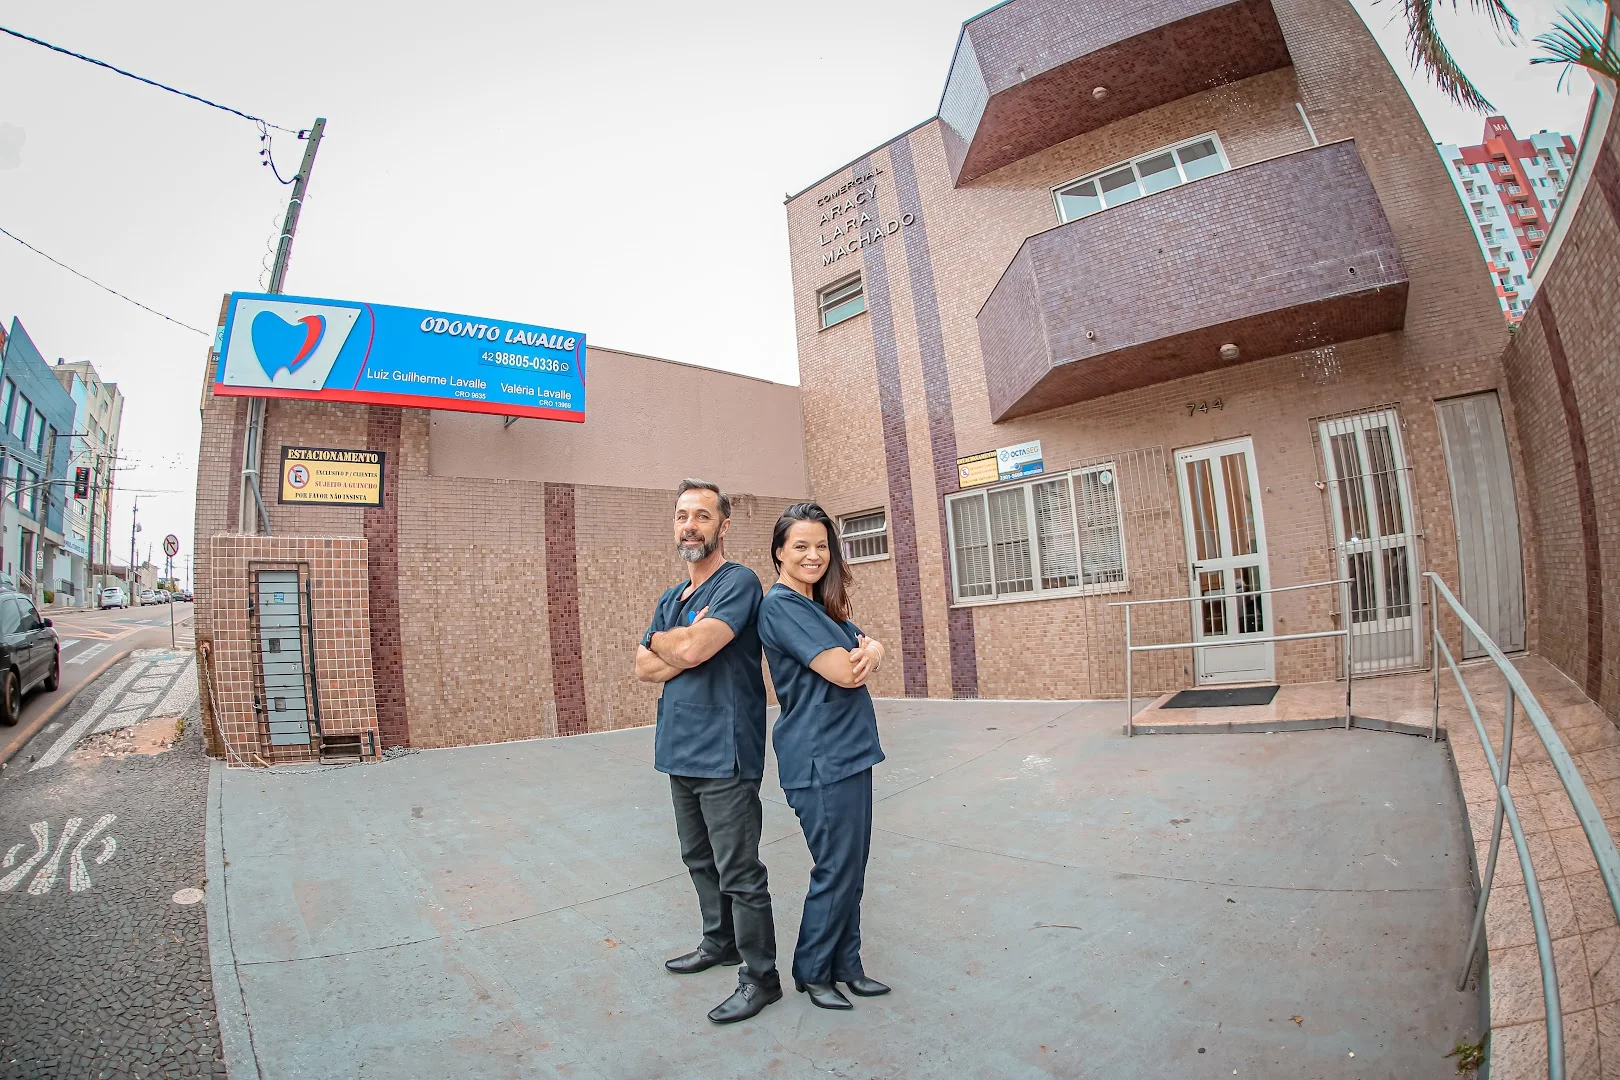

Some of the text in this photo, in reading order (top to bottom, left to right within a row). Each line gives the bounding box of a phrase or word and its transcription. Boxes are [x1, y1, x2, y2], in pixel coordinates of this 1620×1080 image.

[817, 167, 884, 207] COMERCIAL
[819, 184, 877, 226] ARACY
[819, 211, 872, 247] LARA
[822, 212, 915, 267] MACHADO
[420, 316, 576, 351] ODONTO LAVALLE
[482, 351, 560, 372] 42 98805-0336
[367, 368, 487, 389] Luiz Guilherme Lavalle
[454, 390, 470, 398] CRO
[500, 382, 572, 400] Valéria Lavalle
[539, 399, 553, 407] CRO
[1186, 398, 1223, 416] 744
[287, 449, 379, 463] ESTACIONAMENTO
[1010, 446, 1039, 458] OCTASEG
[348, 482, 378, 490] GUINCHO
[329, 492, 342, 500] NÃO
